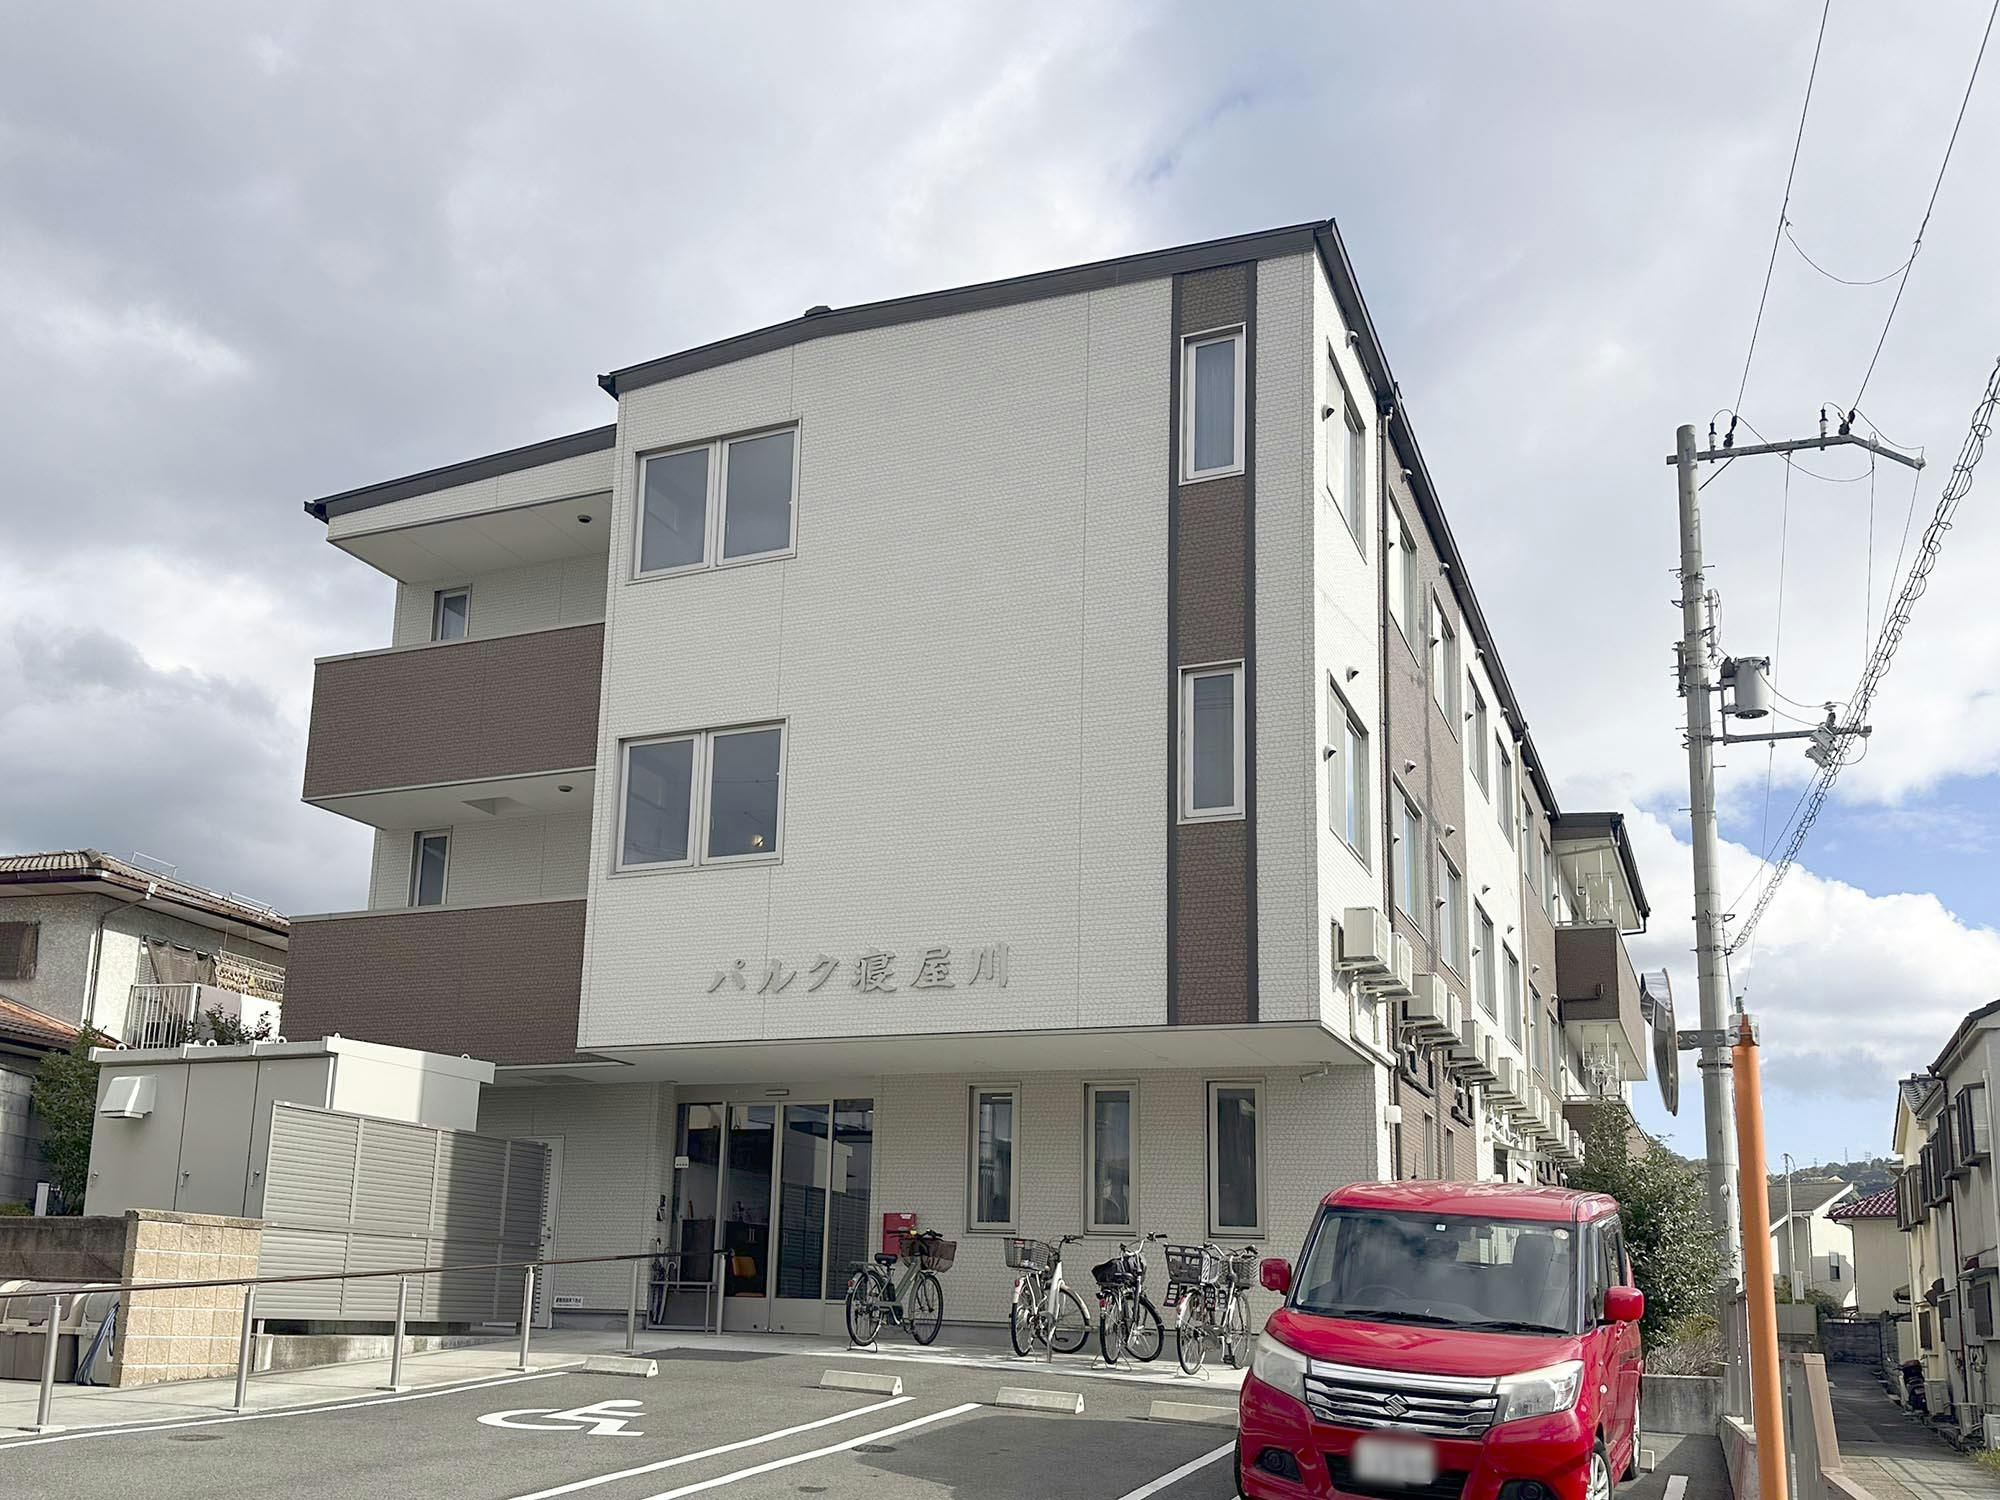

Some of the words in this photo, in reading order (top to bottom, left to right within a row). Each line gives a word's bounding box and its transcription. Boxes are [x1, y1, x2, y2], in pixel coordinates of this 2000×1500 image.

[707, 944, 1009, 994] パルク寝屋川
